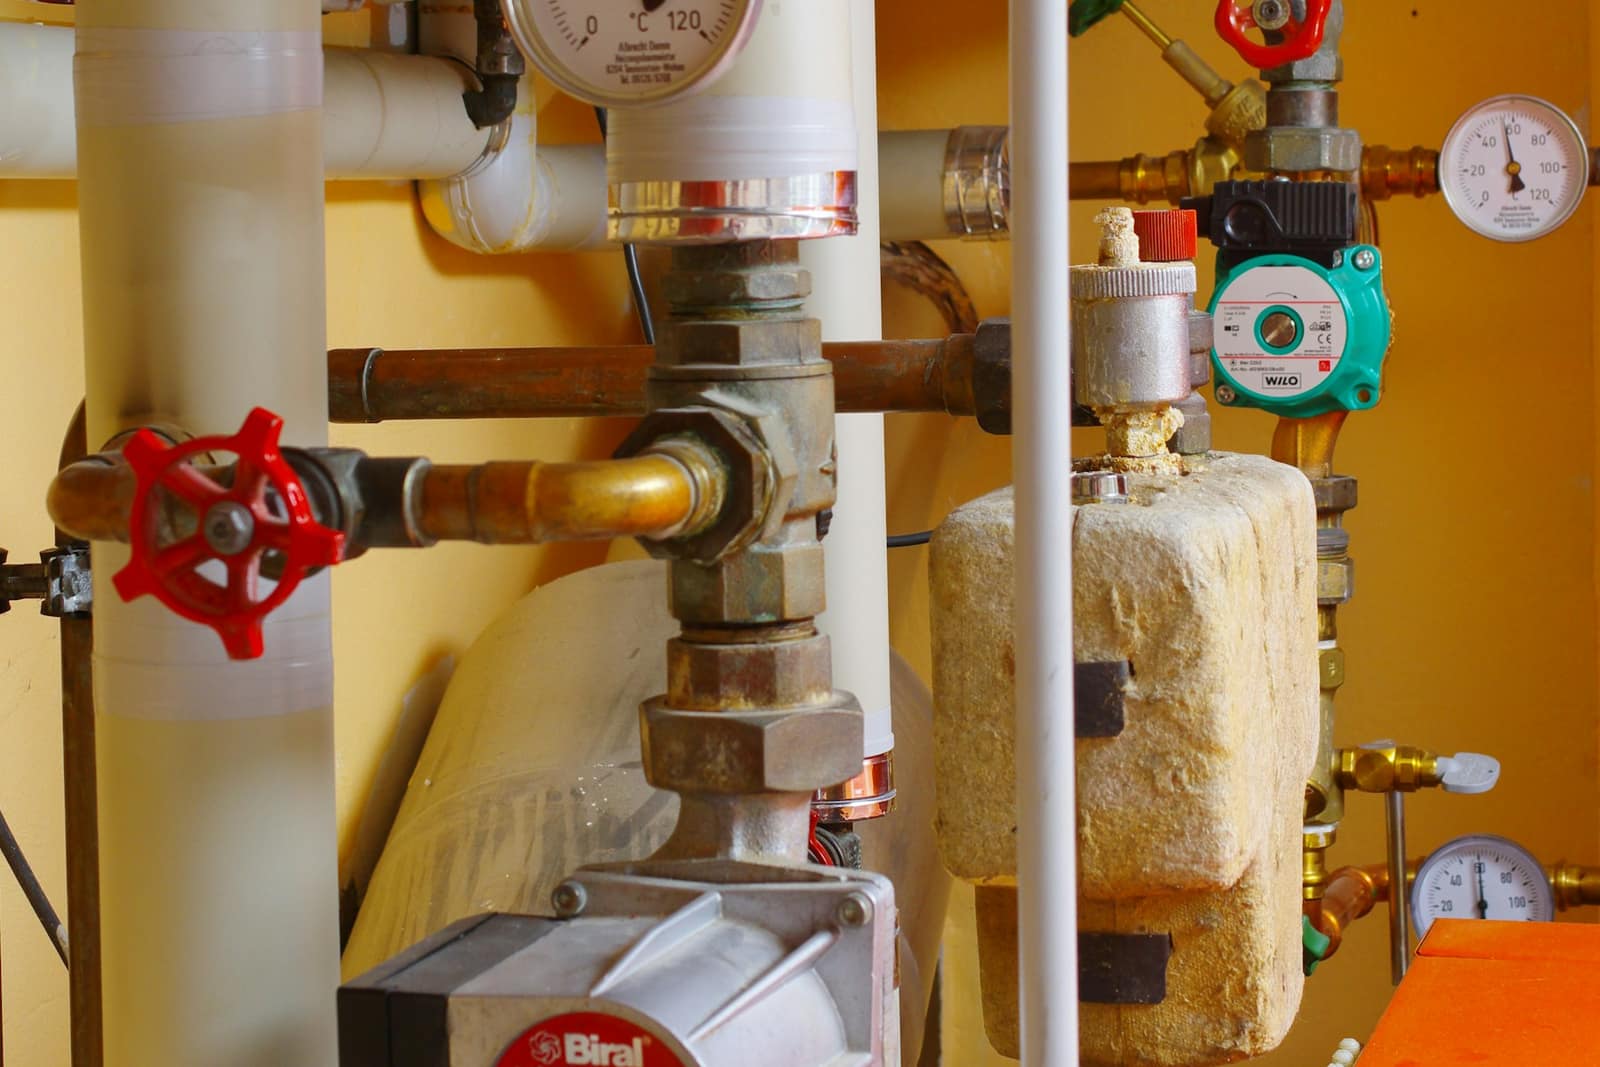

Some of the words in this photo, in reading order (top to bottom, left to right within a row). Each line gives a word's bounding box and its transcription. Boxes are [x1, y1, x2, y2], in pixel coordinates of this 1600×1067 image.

[586, 15, 598, 35] 0
[629, 12, 649, 32] °C
[667, 10, 701, 31] 120
[1505, 123, 1521, 136] 60
[1482, 136, 1497, 148] 40
[1531, 134, 1546, 146] 80
[1470, 164, 1486, 177] 20
[1540, 162, 1560, 174] 100
[1482, 190, 1490, 202] 0
[1530, 188, 1550, 201] 120
[1317, 333, 1332, 345] CE
[1265, 376, 1299, 386] WILO
[1473, 862, 1486, 874] 60
[1450, 874, 1462, 887] 40
[1500, 871, 1513, 884] 80
[1440, 900, 1453, 912] 20
[1508, 896, 1526, 908] 100
[563, 1033, 644, 1067] Biral
